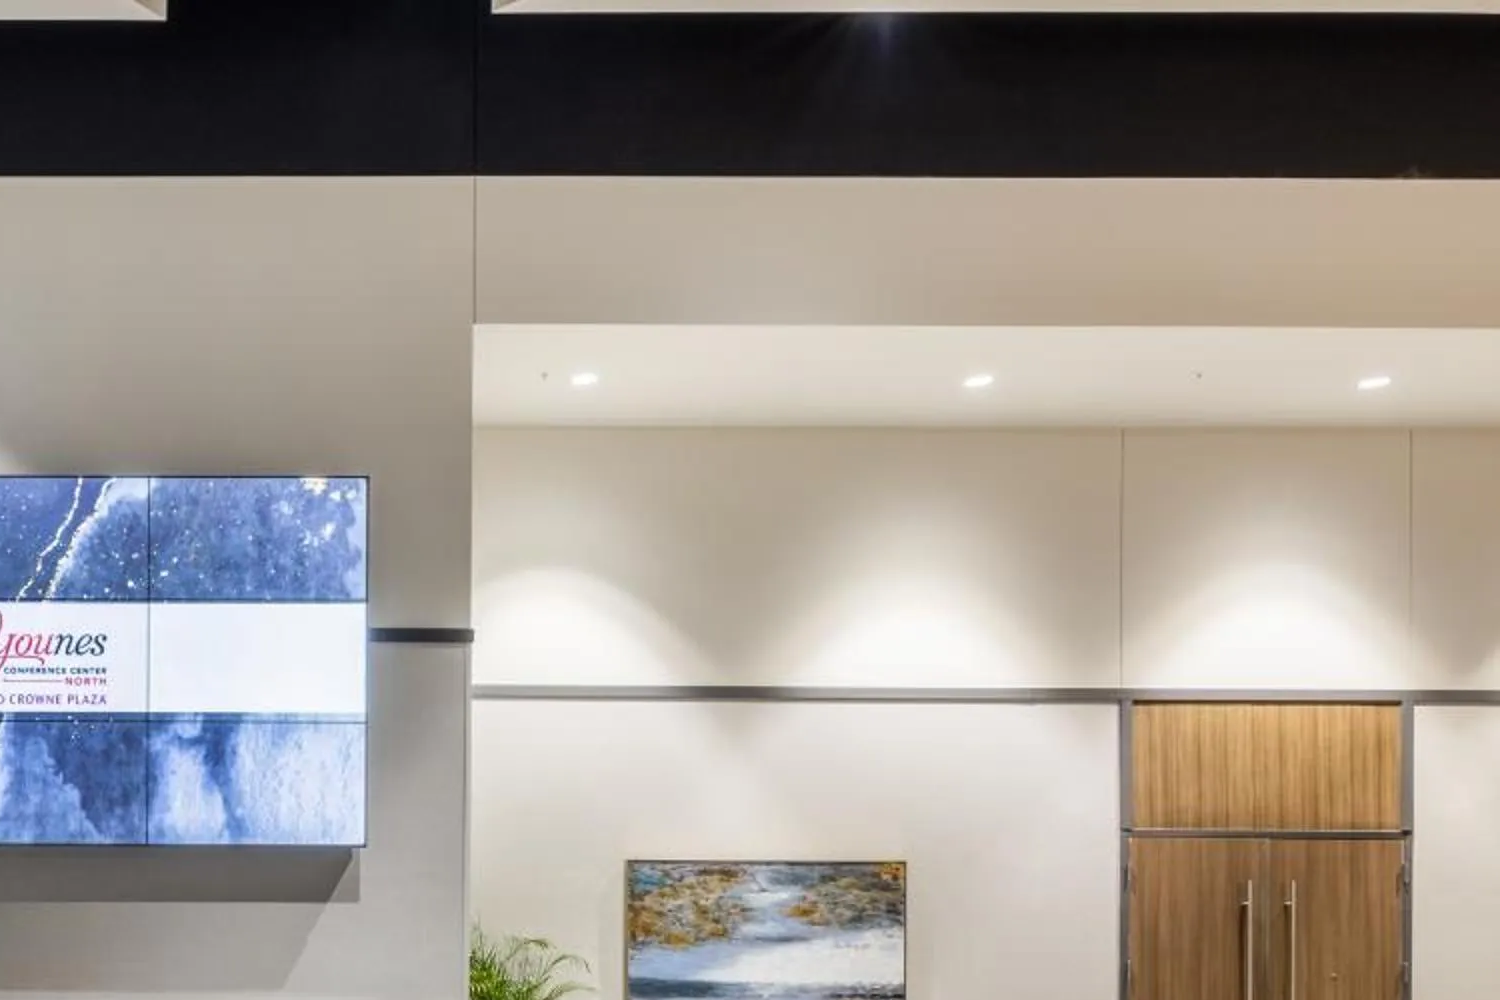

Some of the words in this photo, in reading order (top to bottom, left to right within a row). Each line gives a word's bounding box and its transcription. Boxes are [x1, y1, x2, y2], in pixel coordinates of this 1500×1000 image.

[3, 667, 67, 675] CONFERENCE
[69, 667, 107, 675] CENTER
[65, 676, 107, 686] NORTH
[9, 694, 62, 705] CROWNE
[67, 694, 107, 705] PLAZA
